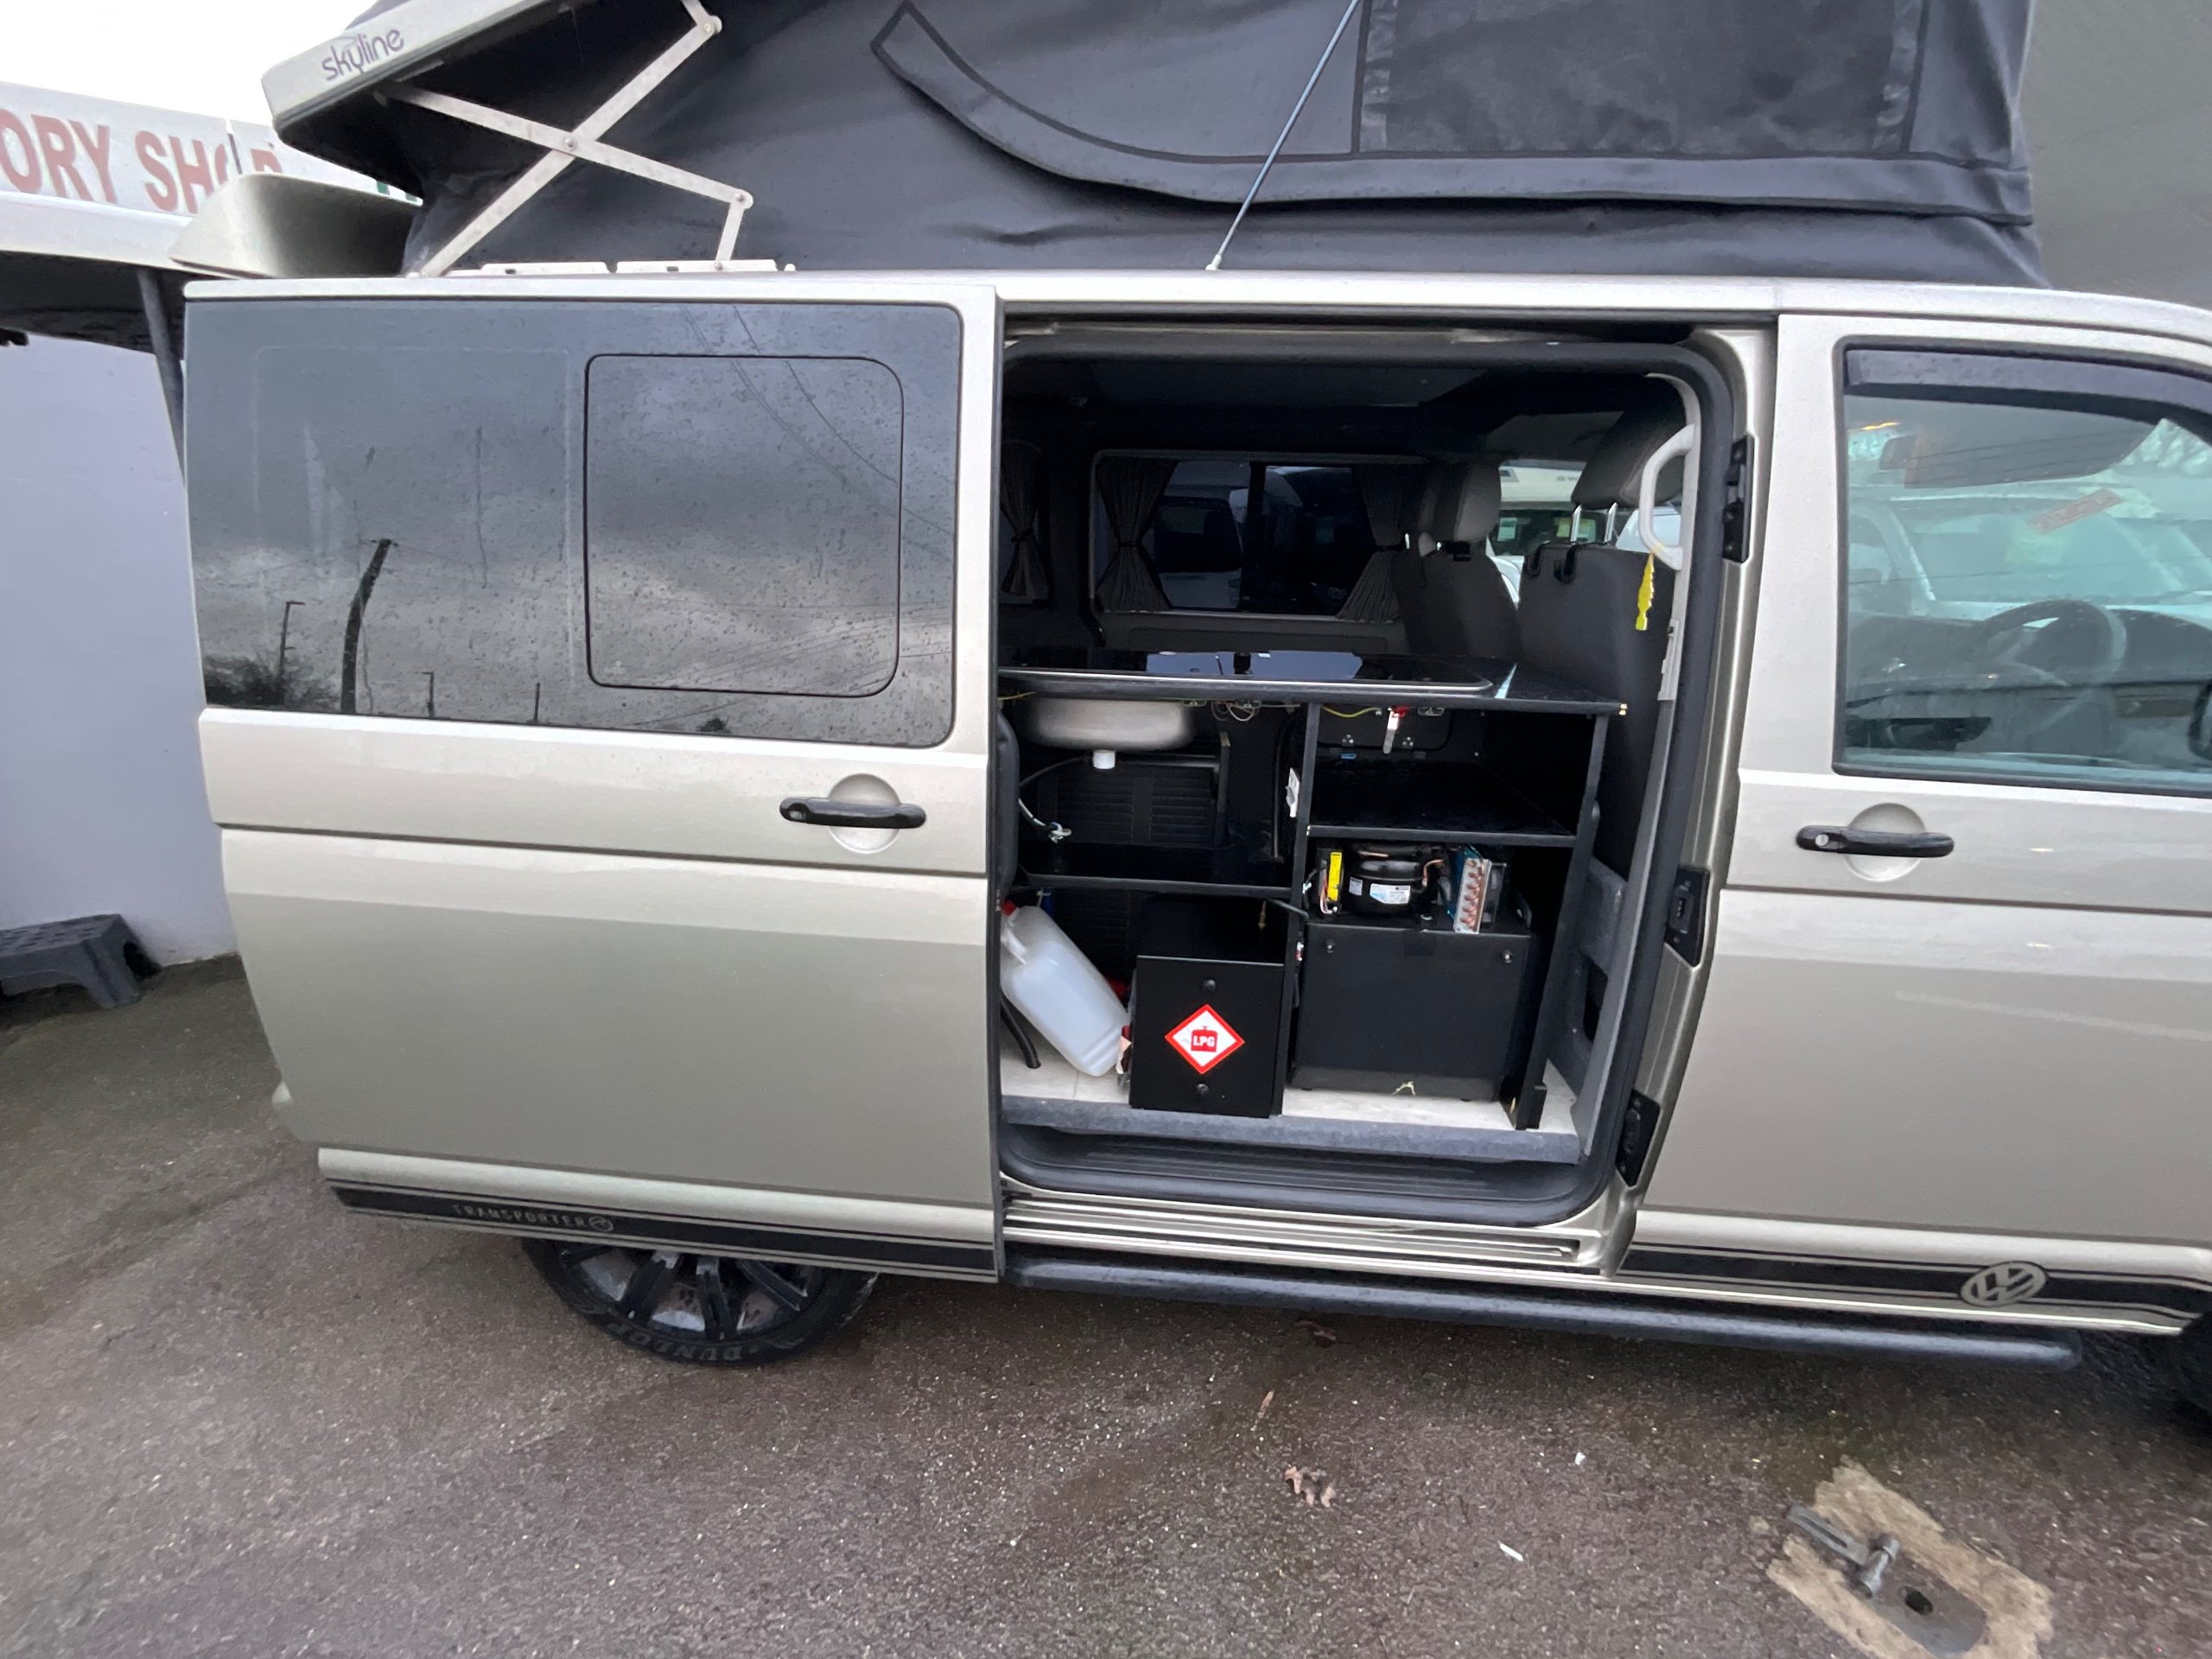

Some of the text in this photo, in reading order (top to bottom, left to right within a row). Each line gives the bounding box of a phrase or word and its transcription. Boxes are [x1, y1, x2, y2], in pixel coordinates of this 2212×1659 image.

[321, 29, 404, 81] skyline
[1192, 1035, 1216, 1047] LPG
[451, 1204, 586, 1228] TRANSPORTER
